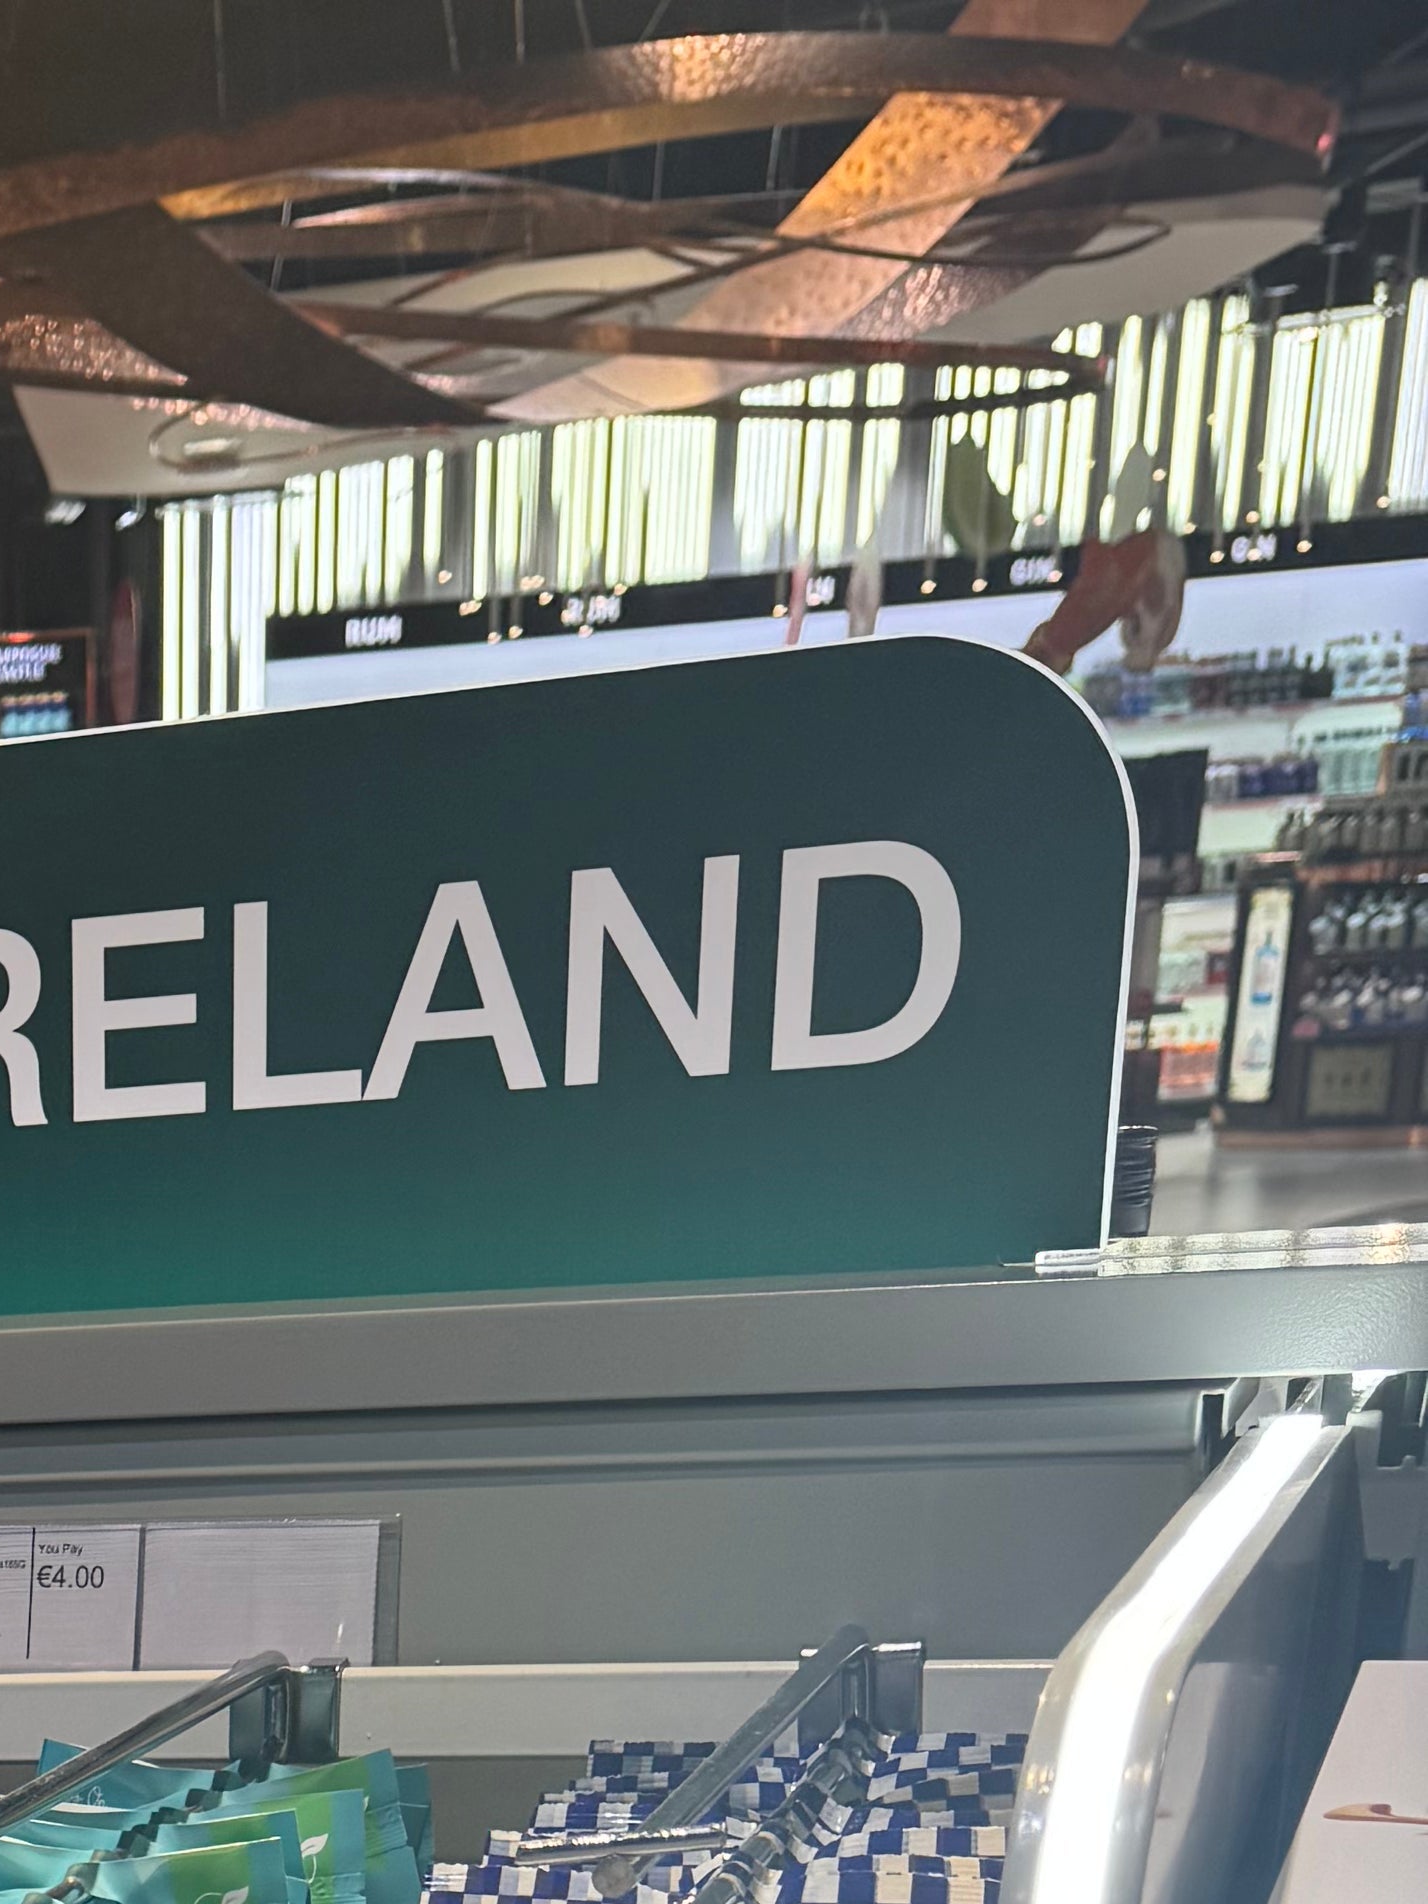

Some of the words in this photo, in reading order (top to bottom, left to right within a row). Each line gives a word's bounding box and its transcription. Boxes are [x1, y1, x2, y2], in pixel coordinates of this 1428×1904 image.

[38, 1542, 59, 1556] You
[62, 1542, 84, 1557] Pay
[37, 1564, 105, 1590] €4.00
